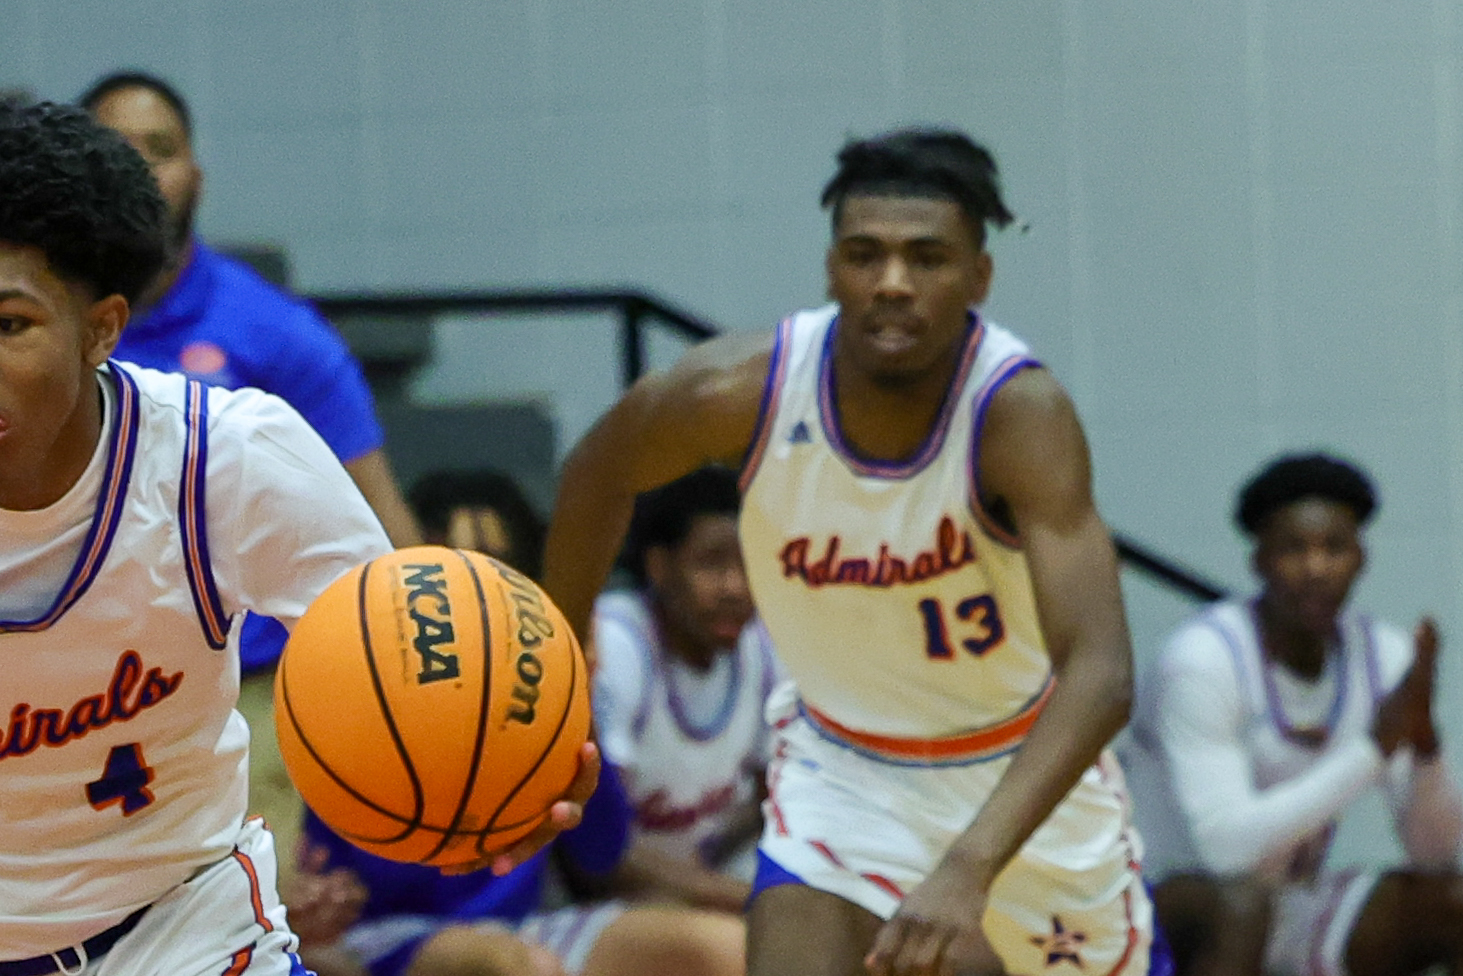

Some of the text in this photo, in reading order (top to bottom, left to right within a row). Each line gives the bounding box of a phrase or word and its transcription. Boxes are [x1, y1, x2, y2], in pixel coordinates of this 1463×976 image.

[401, 563, 460, 685] NCAA
[487, 558, 554, 725] Wilson
[919, 594, 1006, 662] 13
[85, 741, 156, 817] 4
